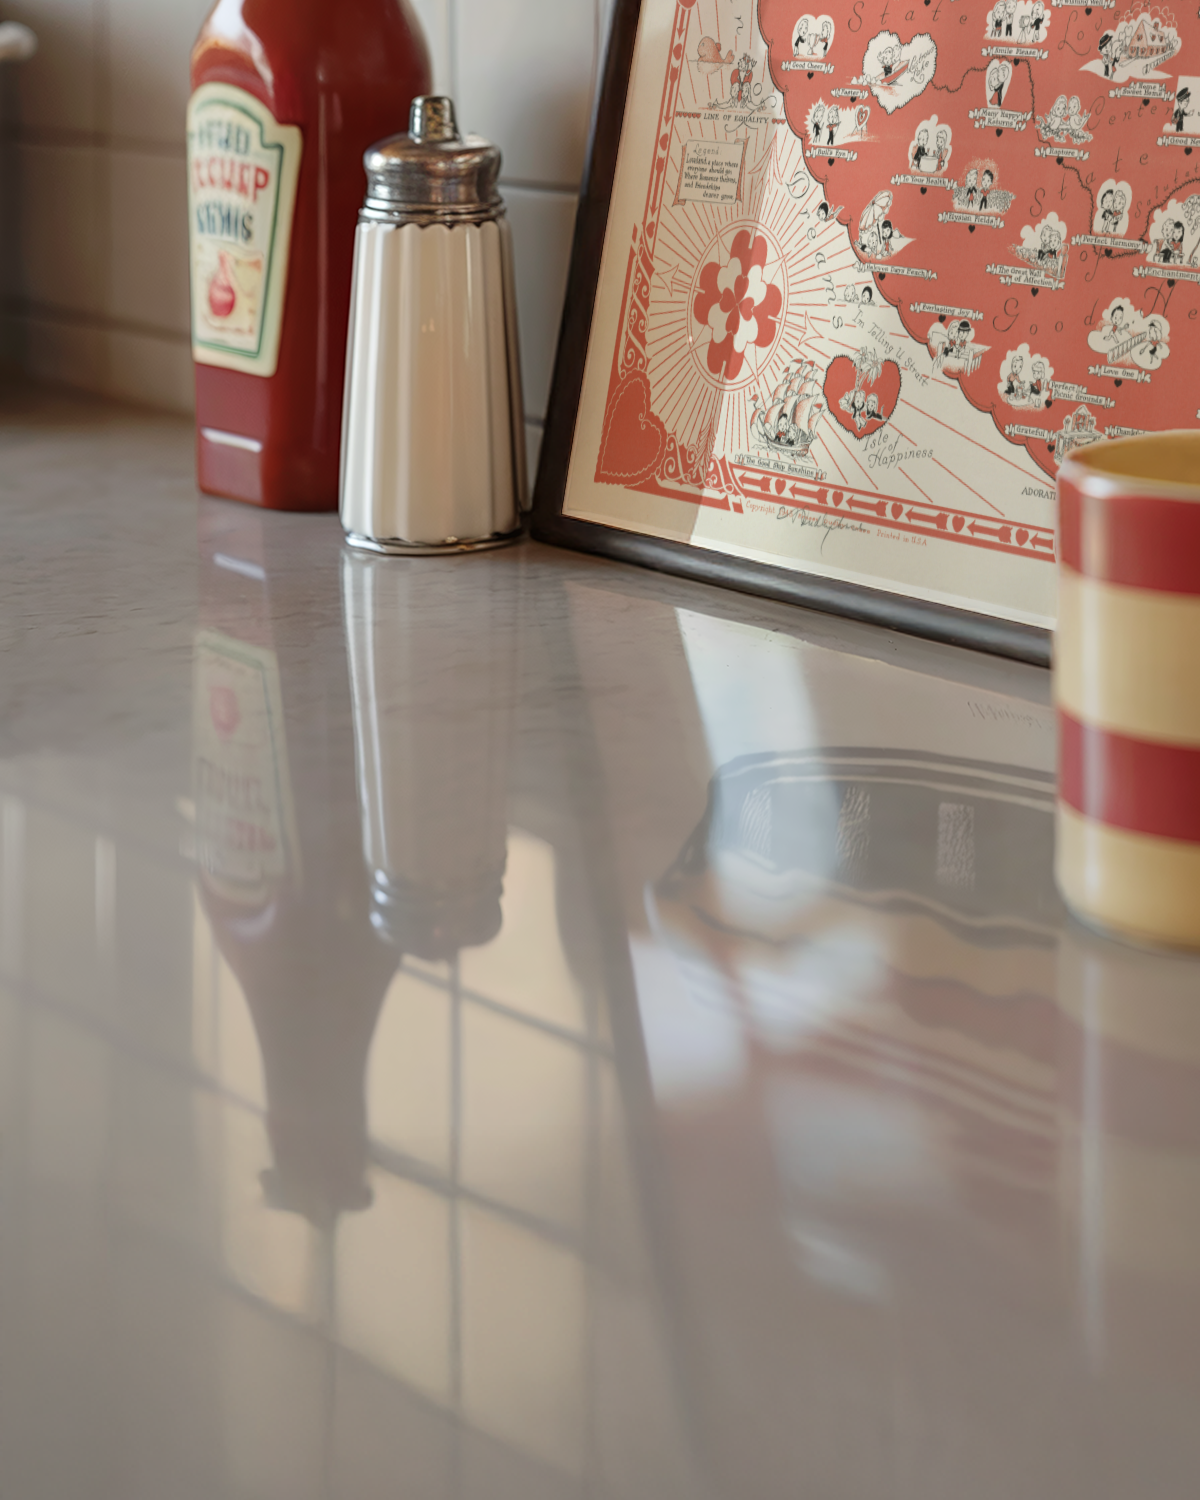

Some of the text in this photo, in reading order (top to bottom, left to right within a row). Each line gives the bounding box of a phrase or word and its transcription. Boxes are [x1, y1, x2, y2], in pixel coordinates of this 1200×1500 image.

[848, 0, 968, 32] State
[1123, 88, 1142, 96] Sweet
[704, 112, 720, 120] LINE
[734, 115, 769, 125] EQUALITY
[981, 110, 1021, 121] Many Happy
[986, 119, 1014, 127] Returns
[1049, 149, 1075, 157] Rapture
[926, 178, 947, 186] Health
[949, 213, 994, 223] Elysian Fields
[993, 146, 1148, 332] State Good
[1082, 236, 1141, 249] Perfect Harmony
[785, 170, 843, 330] Dreams
[891, 267, 925, 277] Days Beach
[999, 266, 1028, 276] The Great
[1147, 267, 1199, 280] Enchantment
[1023, 277, 1053, 286] Affection
[923, 304, 970, 316] Everlasting Joy
[867, 322, 893, 354] Telling
[1103, 367, 1134, 377] Love One
[1051, 381, 1076, 391] Perfect
[1053, 391, 1102, 404] Picnic Grounds
[1015, 426, 1045, 437] Grateful
[862, 433, 889, 452] Isle
[888, 433, 903, 451] of
[758, 459, 769, 468] Good
[868, 449, 933, 469] Happiness
[745, 500, 901, 541] Copyright Printed
